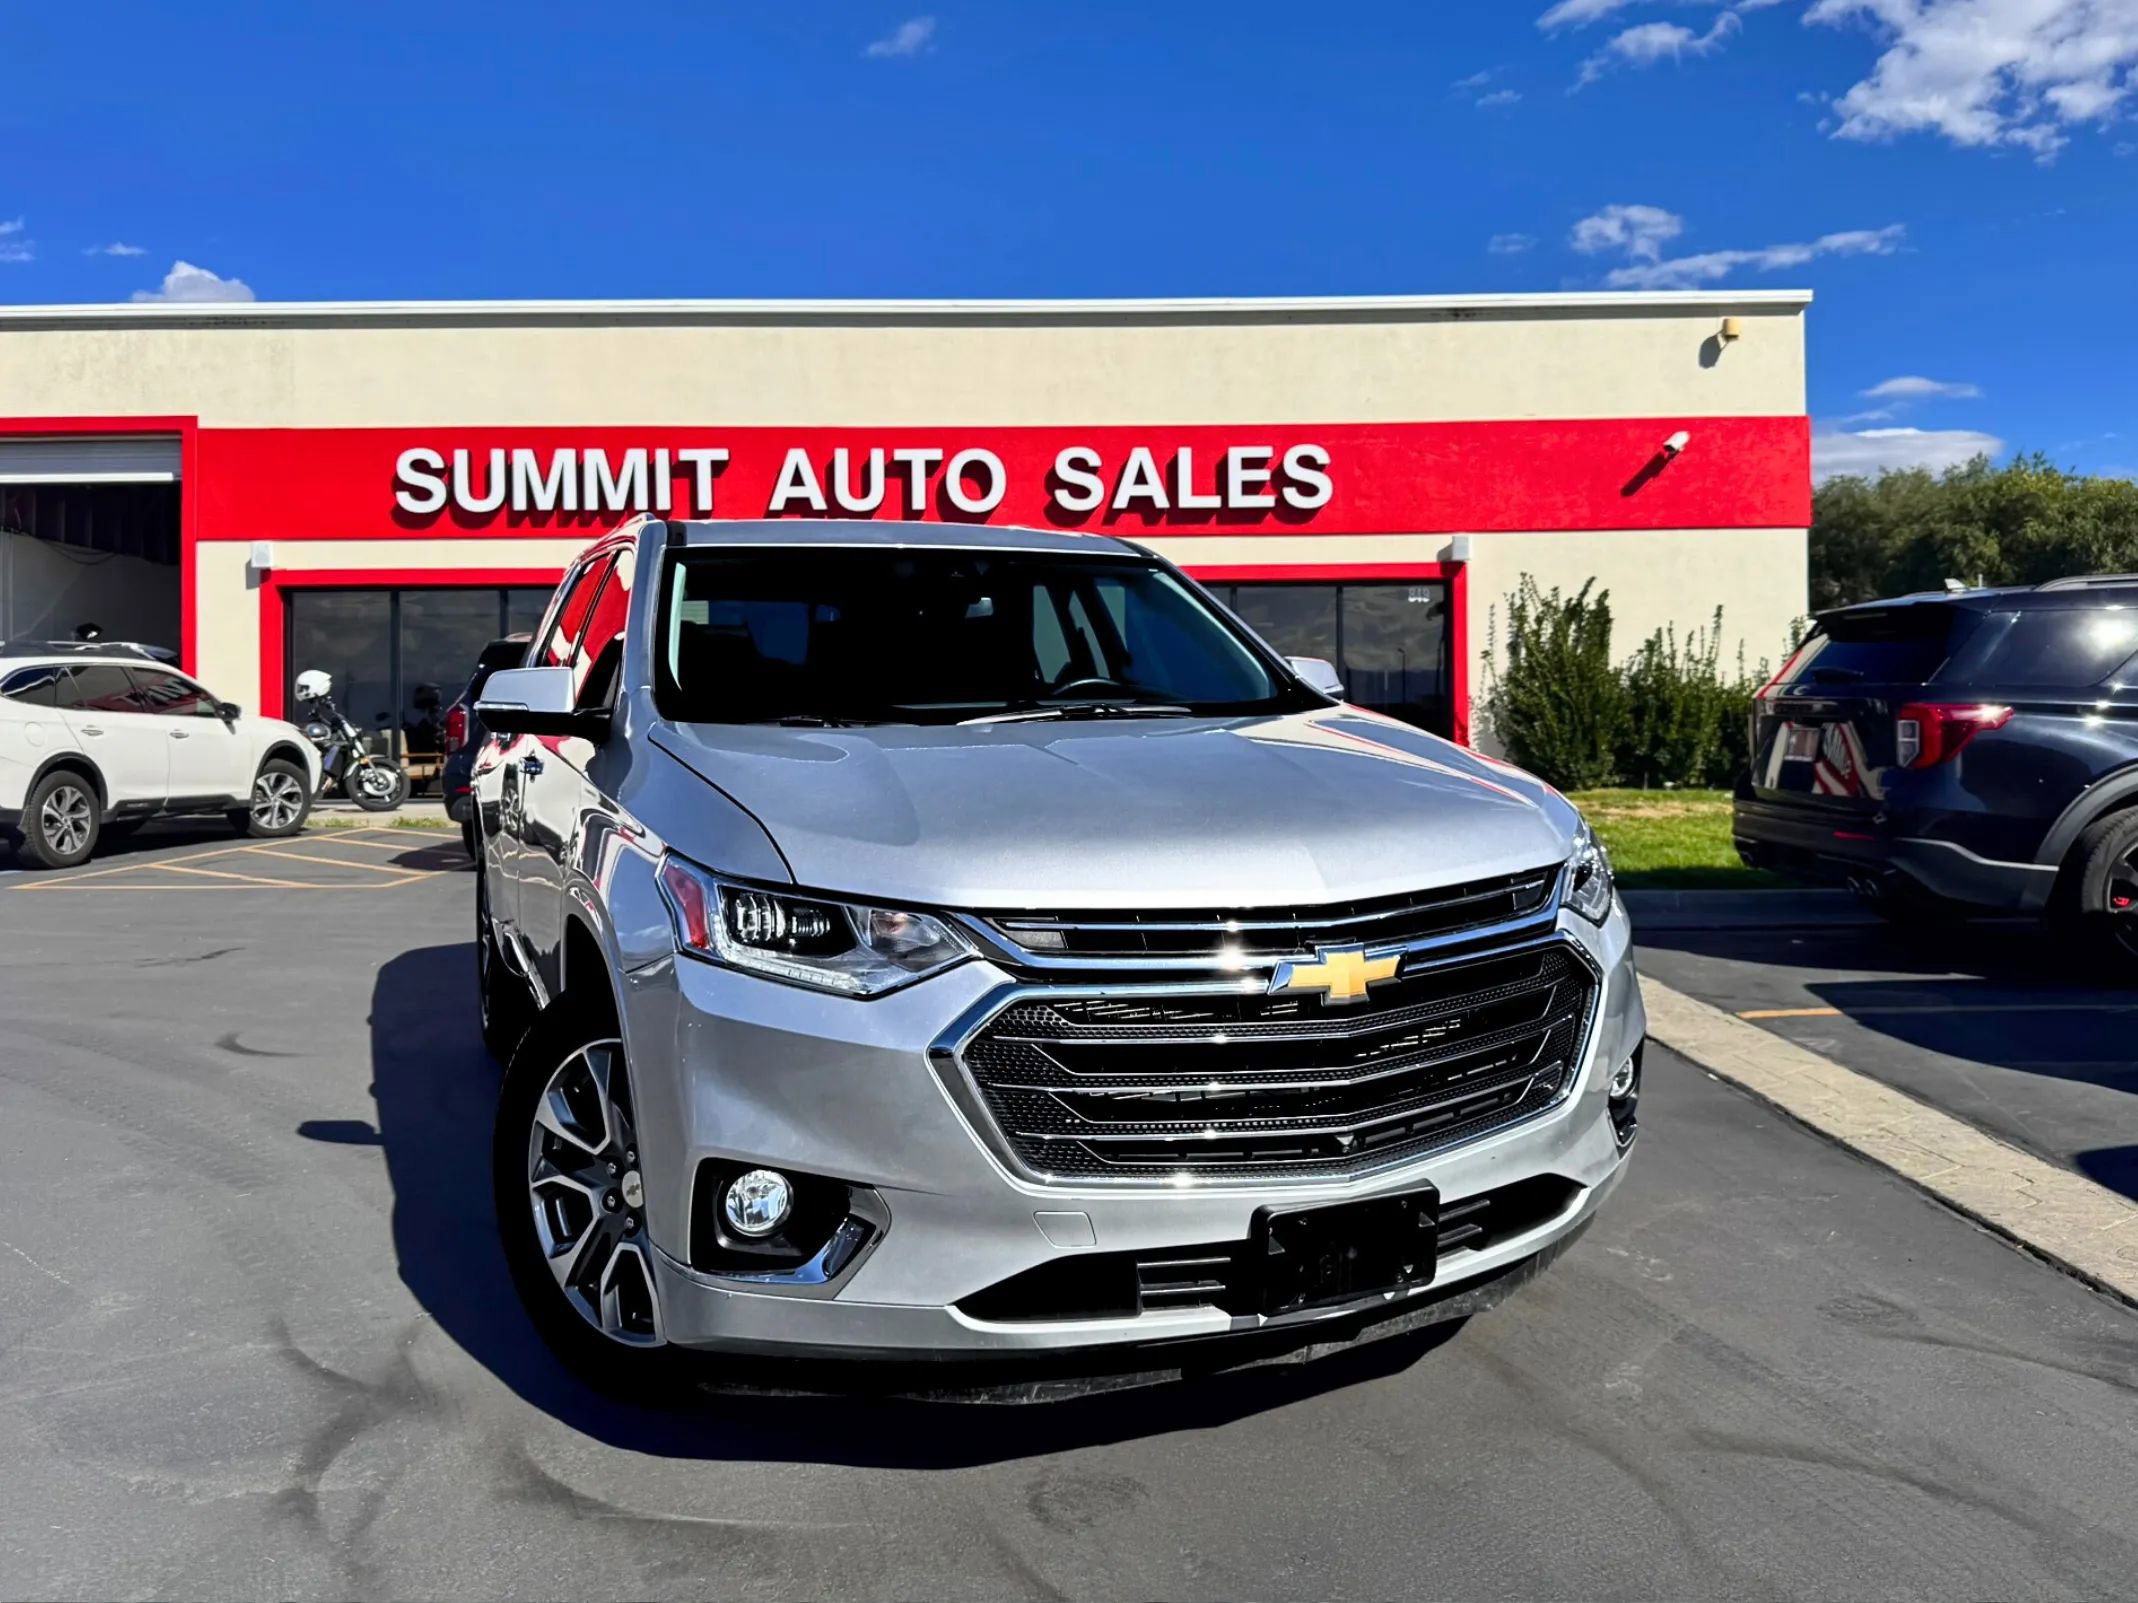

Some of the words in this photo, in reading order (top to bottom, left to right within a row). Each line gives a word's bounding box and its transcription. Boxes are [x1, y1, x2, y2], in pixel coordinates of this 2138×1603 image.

[395, 447, 729, 514] SUMMIT
[768, 447, 1007, 513] AUTO
[1053, 444, 1333, 511] SALES
